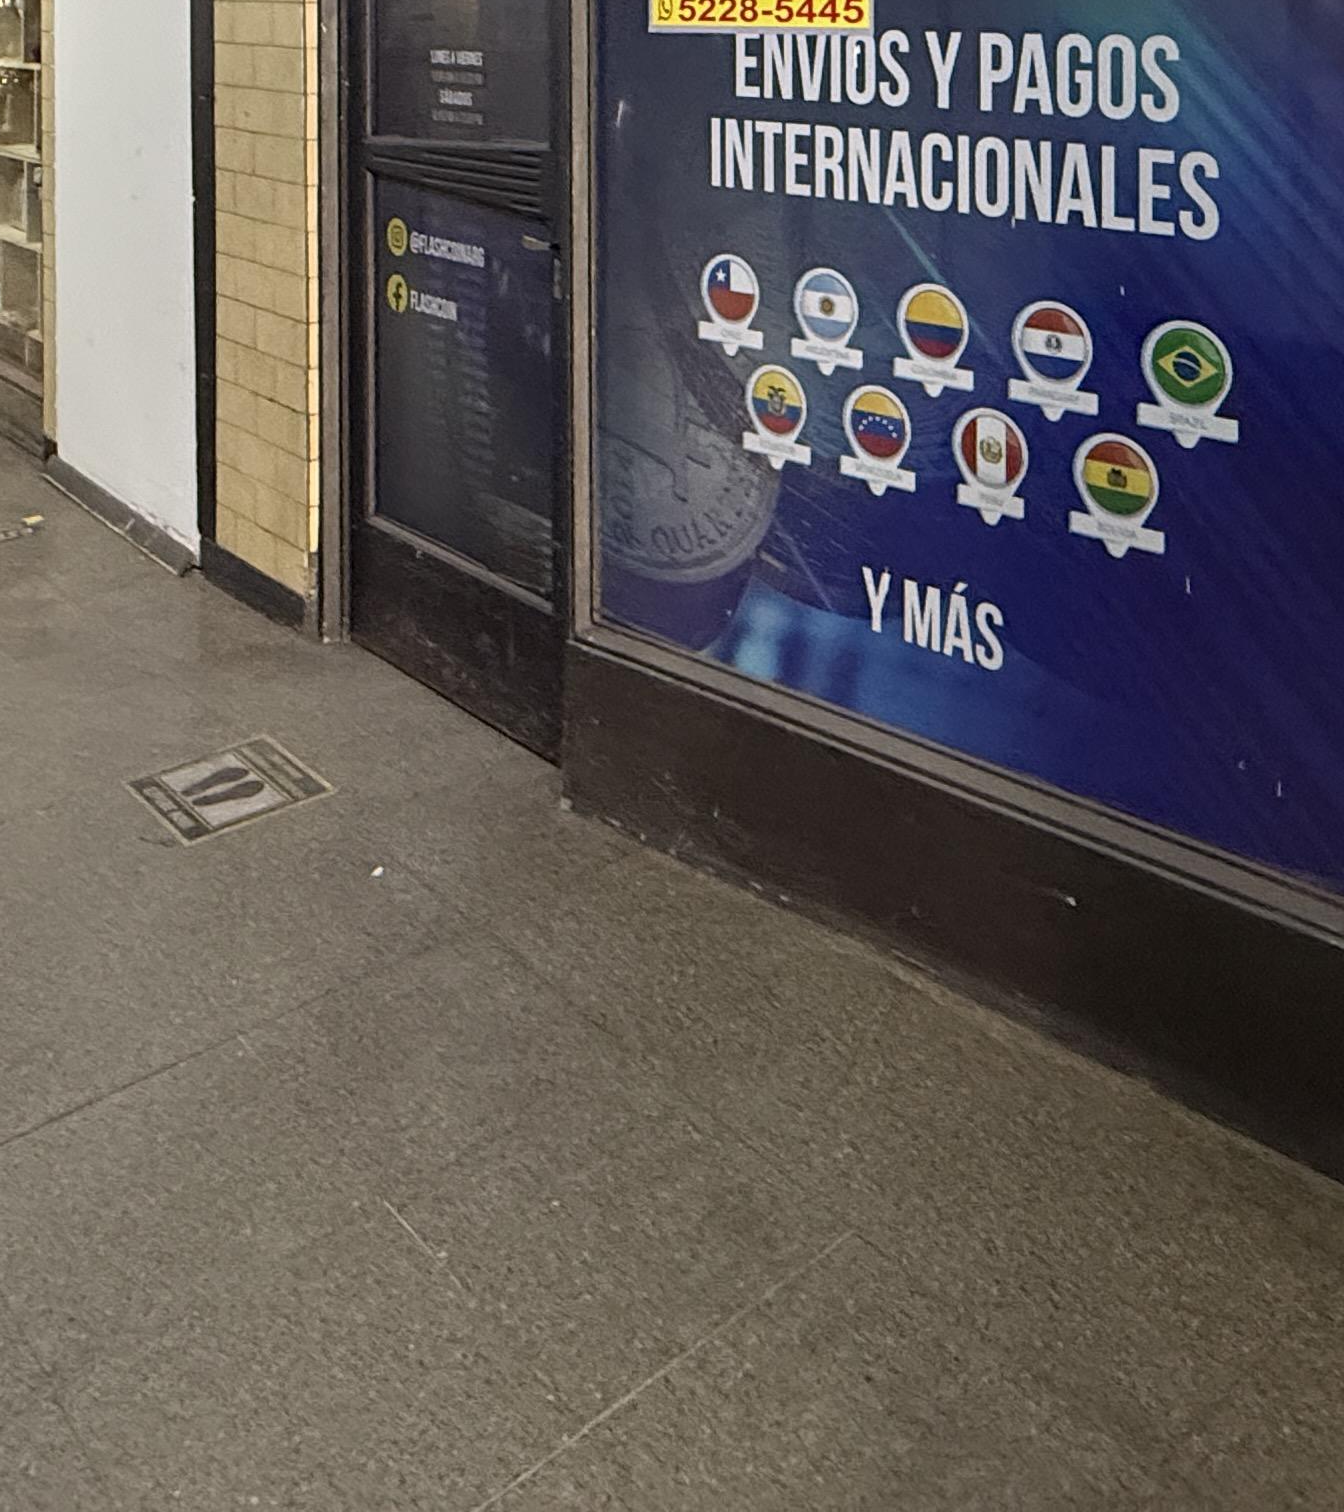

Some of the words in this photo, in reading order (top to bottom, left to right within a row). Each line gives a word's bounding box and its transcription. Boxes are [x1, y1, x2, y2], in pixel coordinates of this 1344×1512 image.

[926, 32, 962, 110] Y
[979, 33, 1181, 122] PAGOS
[711, 118, 1221, 241] INTERNACIONALES
[862, 566, 891, 633] Y
[904, 582, 1005, 671] MÁS
